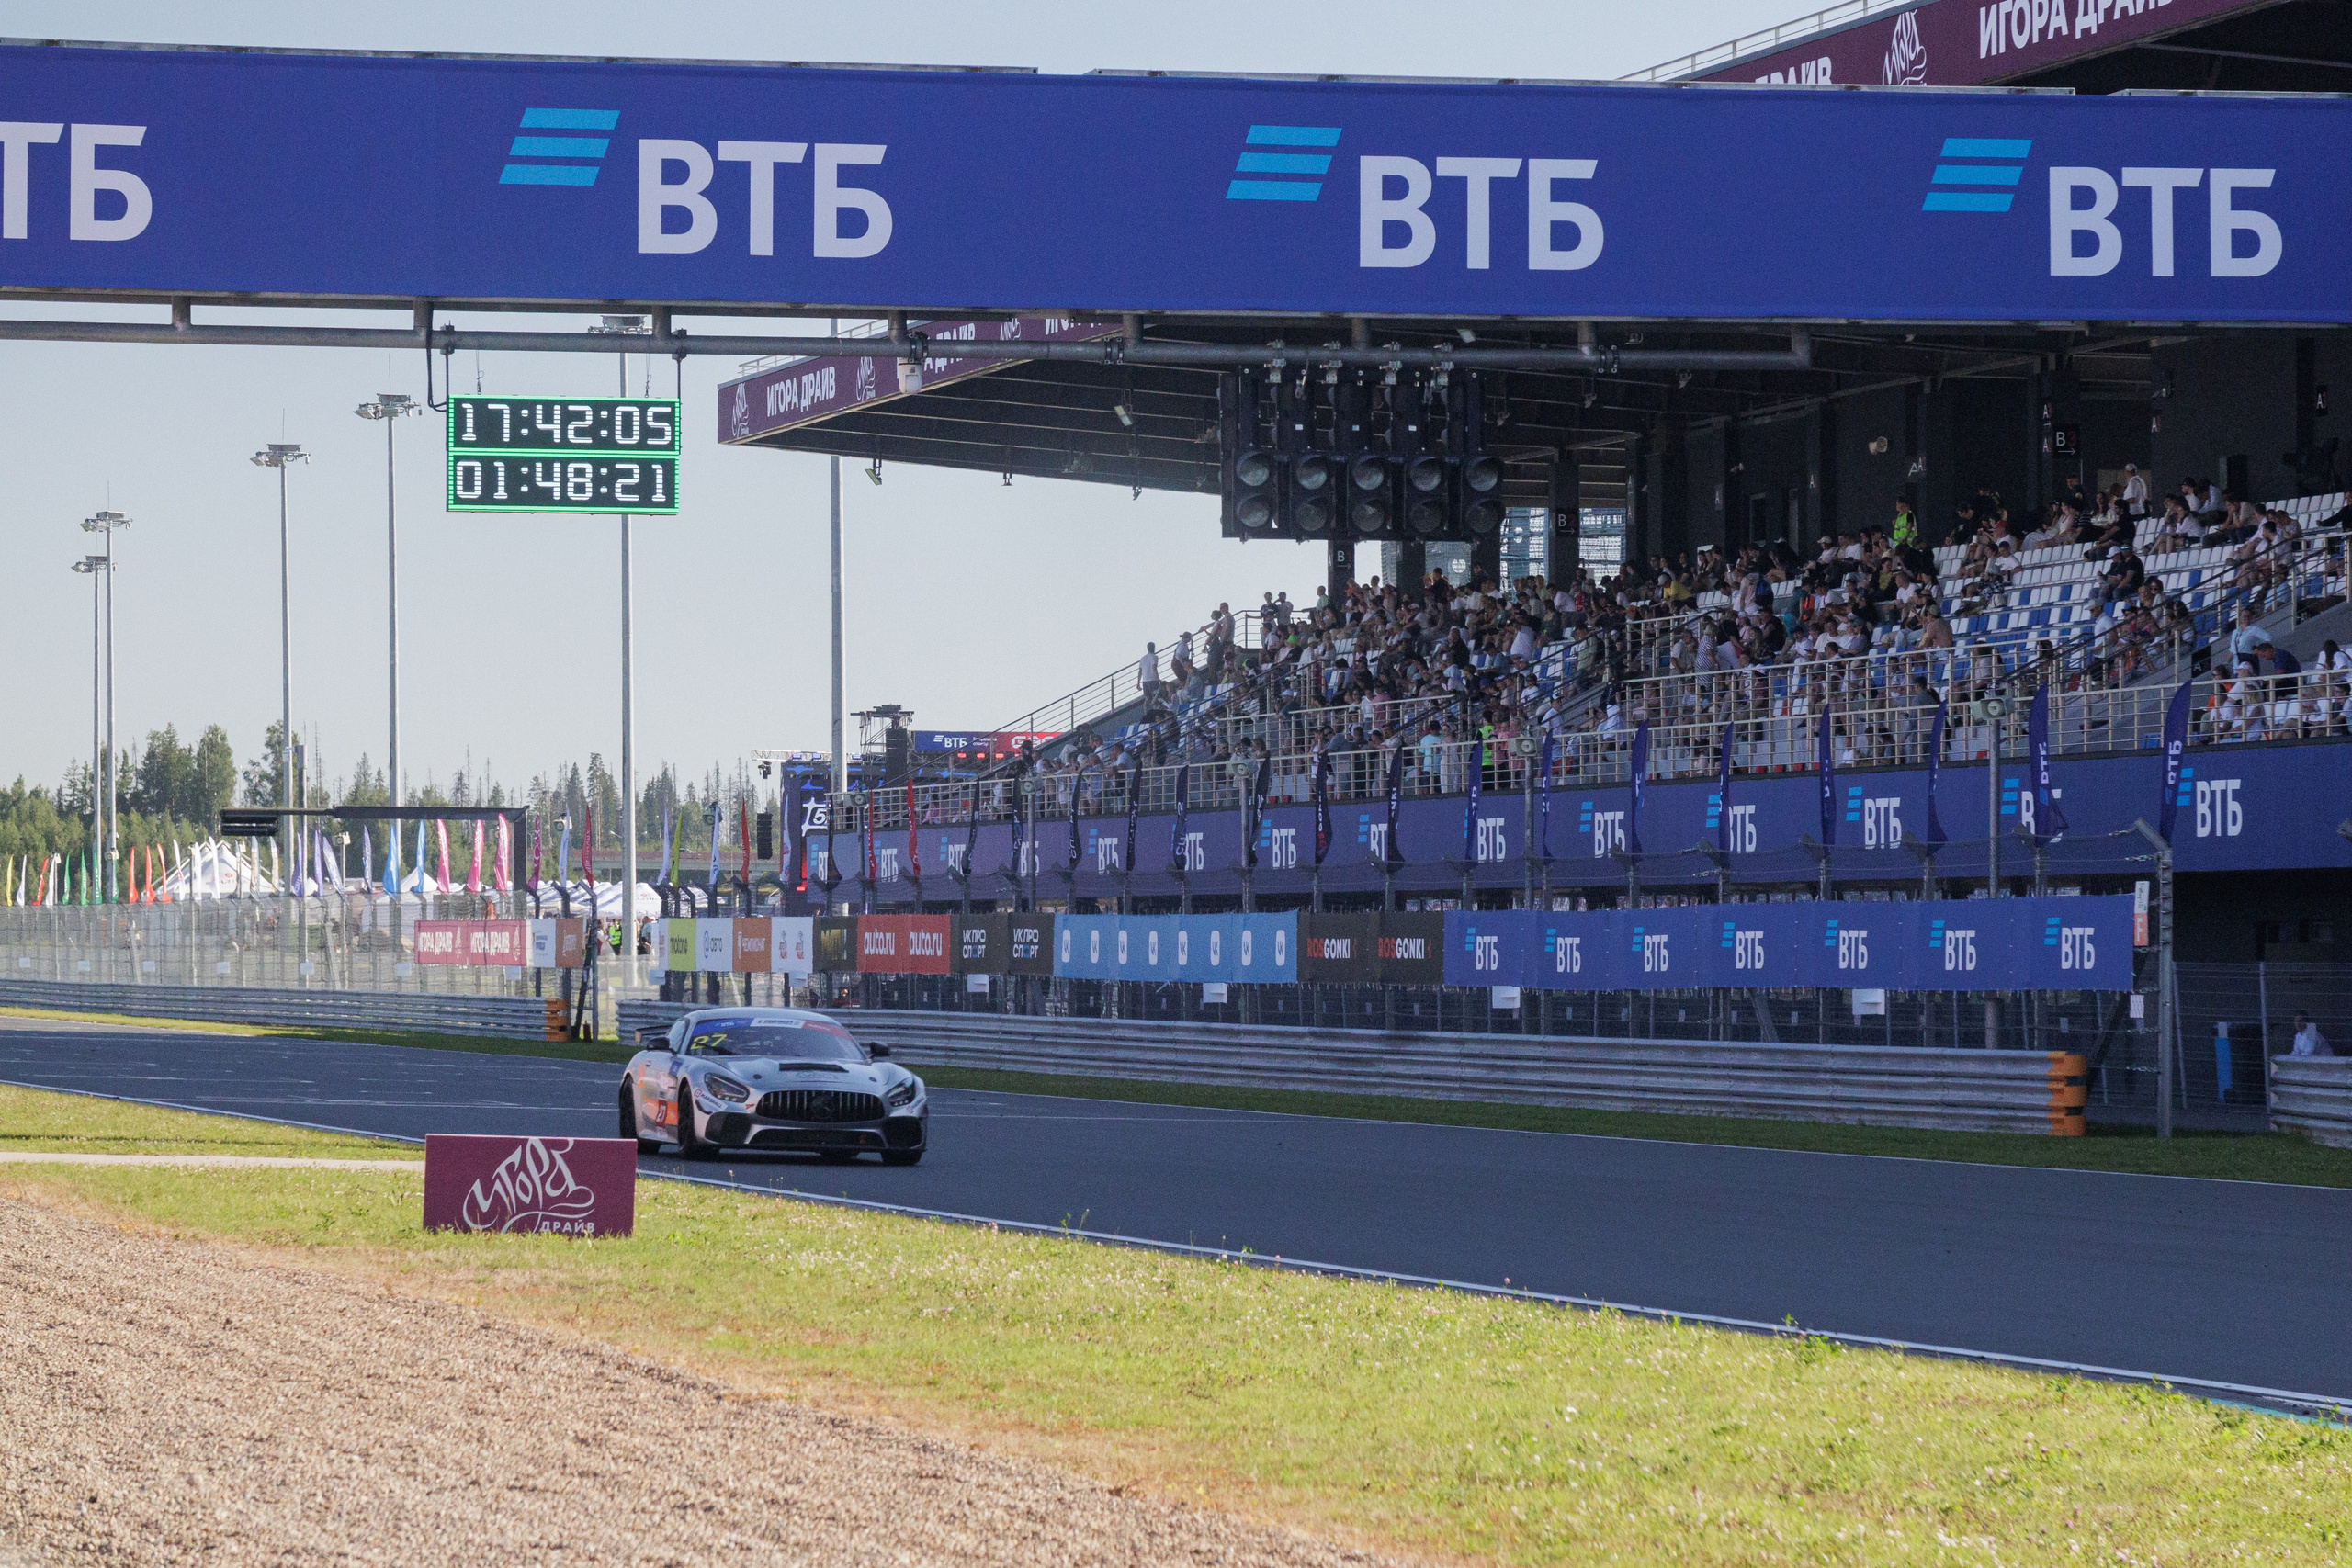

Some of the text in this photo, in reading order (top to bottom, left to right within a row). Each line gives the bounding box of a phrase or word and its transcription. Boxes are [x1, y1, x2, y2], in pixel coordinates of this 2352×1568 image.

[638, 138, 894, 259] ВТБ
[1359, 155, 1605, 271] ВТБ
[2048, 166, 2283, 277] ВТБ
[766, 378, 799, 417] ИГОРА
[461, 402, 673, 446] 17:42:05
[456, 461, 668, 502] 01:48:21
[944, 737, 967, 748] ВТБ
[1864, 797, 1902, 850] ВТБ
[2196, 778, 2243, 838] ВТБ
[1272, 828, 1297, 869] ВТБ
[1370, 823, 1388, 862] ВТ
[1477, 818, 1506, 863] ВТБ
[1594, 811, 1625, 858] ВТБ
[881, 848, 899, 882] ВТБ
[864, 928, 895, 955] auto.ru
[909, 928, 943, 956] auto.ru
[1307, 938, 1351, 959] ROSGONKI
[1378, 937, 1424, 959] ROSGONKI
[1476, 935, 1498, 971] ВТБ
[1556, 936, 1581, 974] ВТБ
[1643, 934, 1668, 972] ВТБ
[1736, 931, 1764, 969] ВТБ
[1839, 930, 1868, 969] ВТБ
[1945, 929, 1976, 971] ВТБ
[2061, 927, 2095, 970] ВТБ
[690, 1033, 727, 1050] 27
[539, 1219, 594, 1233] ДРАЙВ
